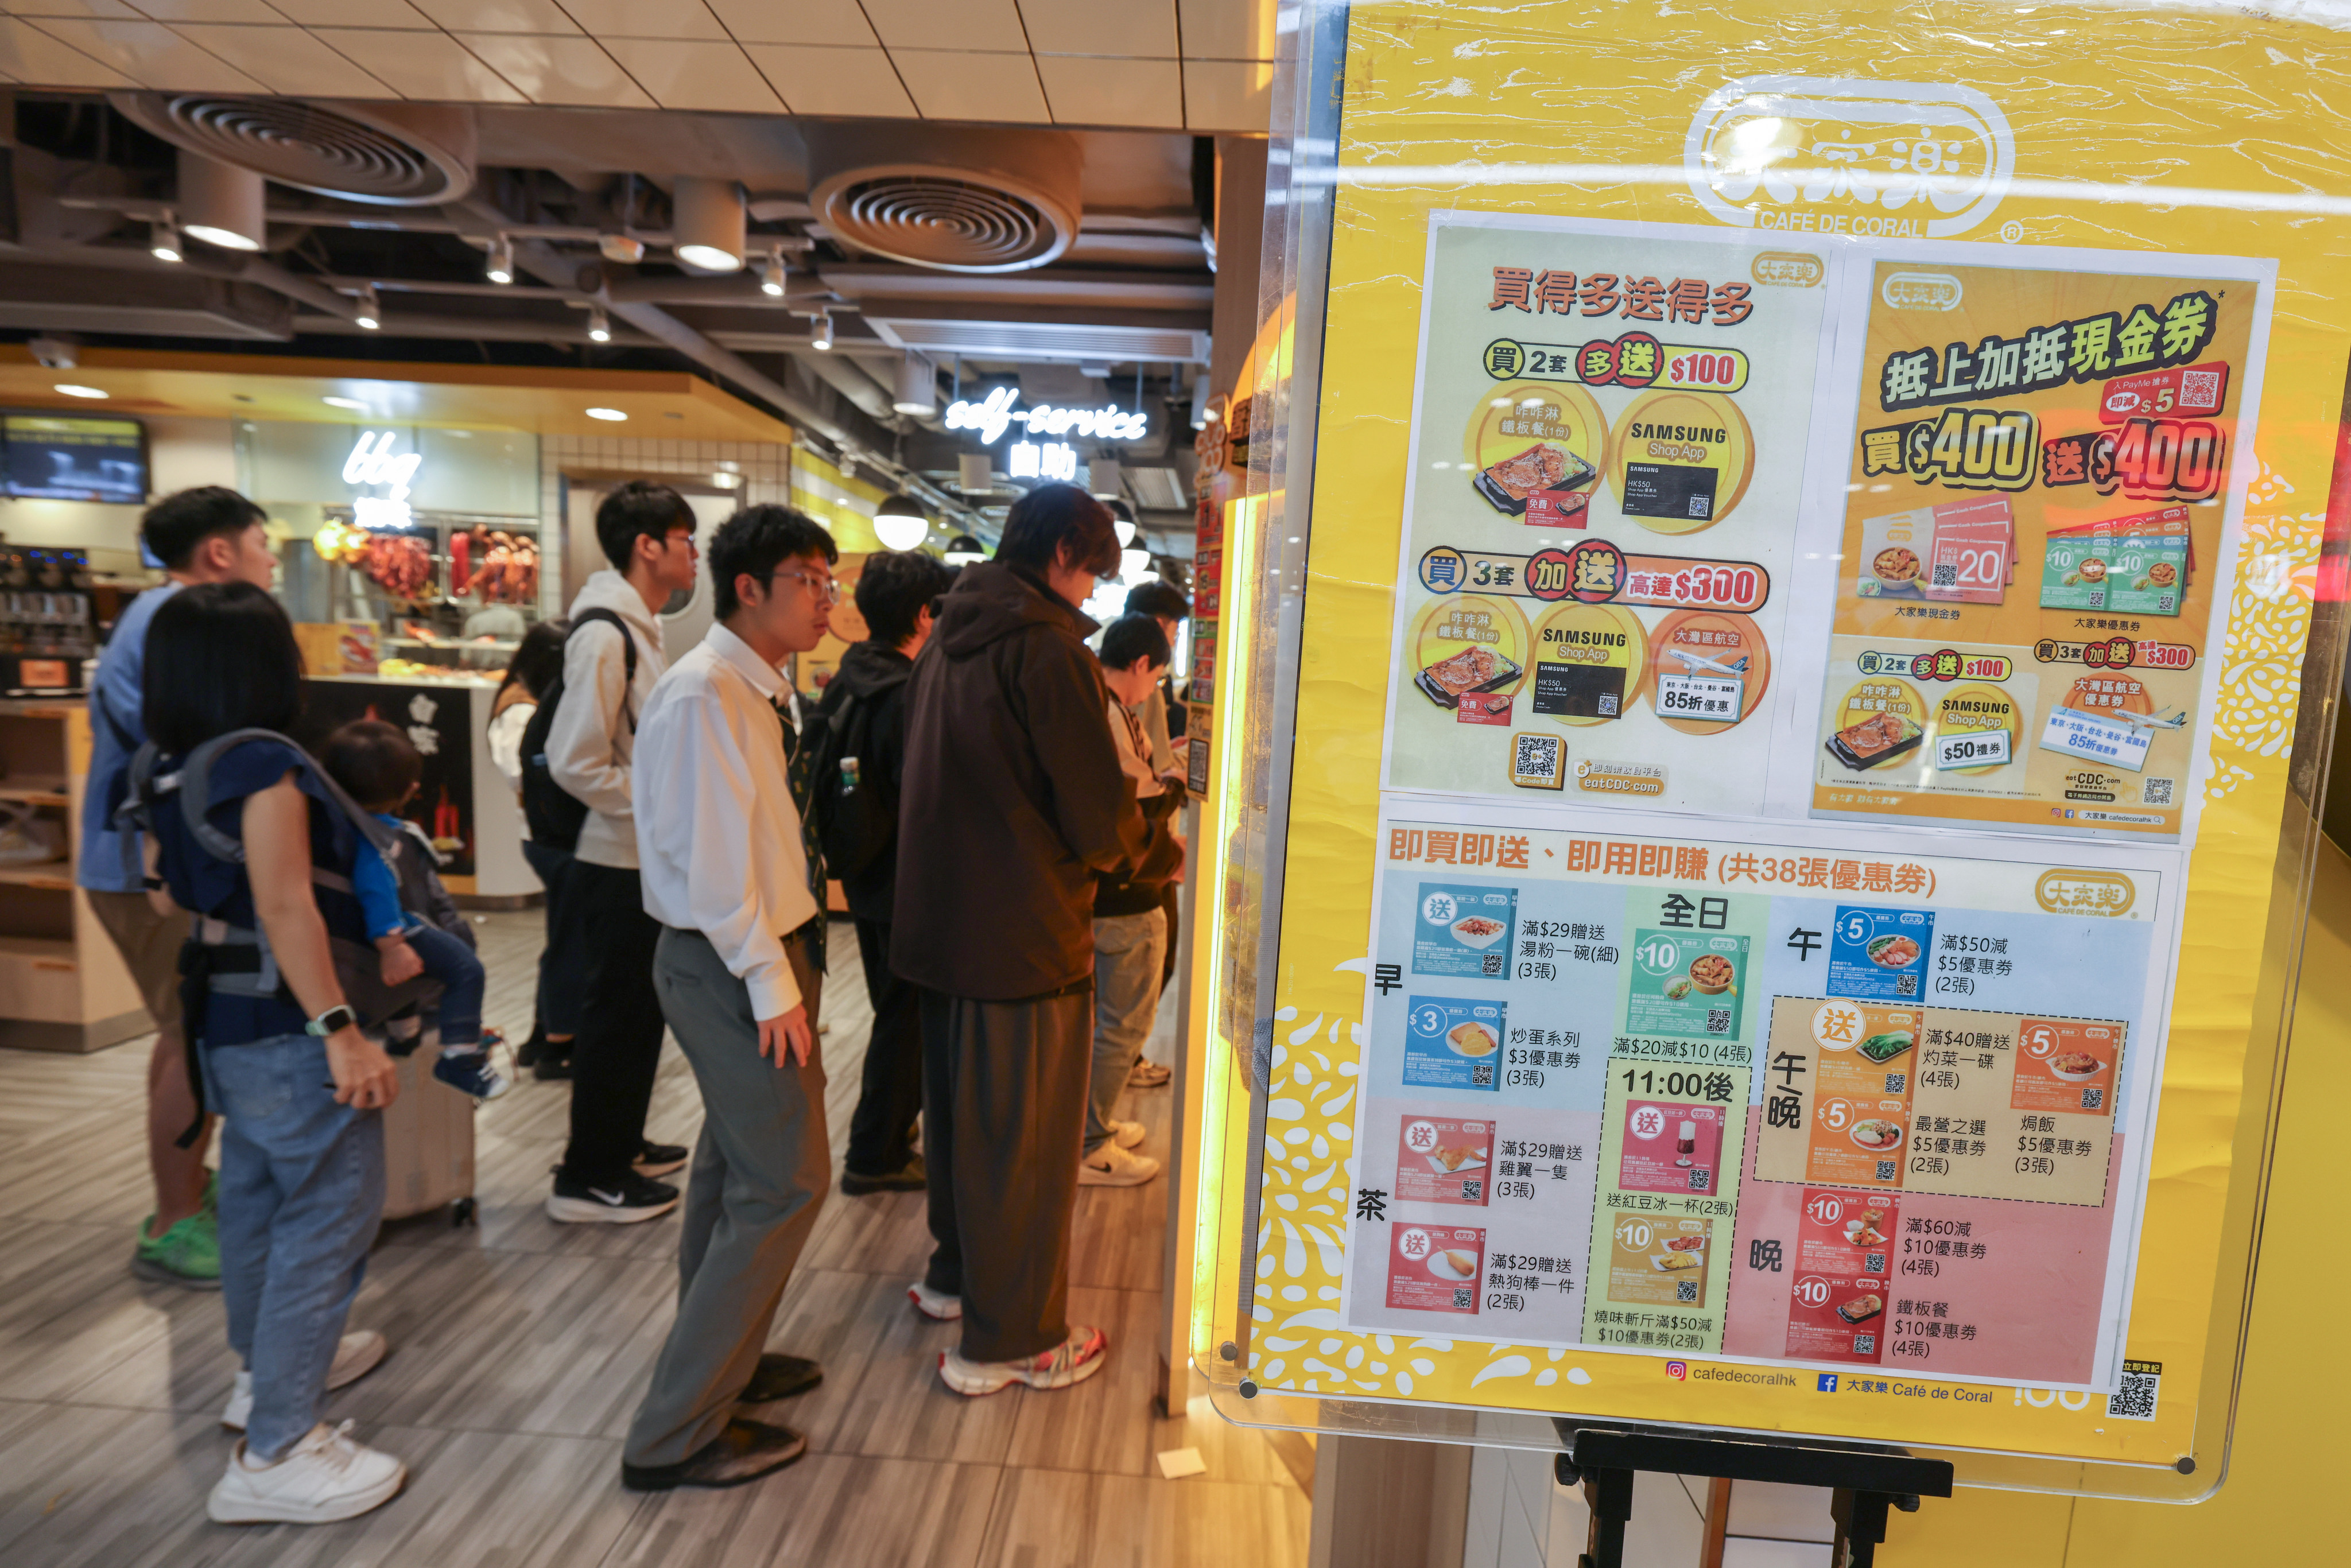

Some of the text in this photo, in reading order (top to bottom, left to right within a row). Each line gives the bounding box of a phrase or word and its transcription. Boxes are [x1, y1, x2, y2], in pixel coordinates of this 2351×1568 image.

[1760, 209, 1924, 238] CAFÉ DE CORAL
[1487, 266, 1753, 325] 買得多送得多
[1491, 347, 1516, 372] 買
[1529, 350, 1567, 374] 2套
[1670, 353, 1736, 386] $100
[2123, 379, 2151, 390] PayMe
[2110, 394, 2136, 408] 即減
[1631, 422, 1727, 444] SAMSUNG
[1650, 443, 1705, 460] Shop App
[1863, 412, 2028, 477] 買 $400
[2046, 421, 2212, 488] 送 $400
[1630, 465, 1659, 473] SAMSUNG
[1628, 480, 1650, 488] HK$50
[1529, 499, 1547, 509] 免費
[1957, 549, 2000, 584] 20
[2046, 549, 2071, 568] $10
[2116, 554, 2142, 572] $10
[1430, 557, 1457, 585] 買
[1473, 561, 1514, 587] 3套
[1543, 628, 1626, 647] SAMSUNG
[1675, 630, 1739, 646] 大灣區航空
[1559, 646, 1608, 662] Shop App
[1733, 659, 1746, 669] GBA
[2039, 643, 2054, 659] 買
[2059, 646, 2082, 659] 3套
[2147, 648, 2189, 666] $300
[1863, 654, 1877, 670] 買
[1884, 657, 1907, 671] 2套
[1966, 658, 2003, 677] $100
[1538, 679, 1560, 688] HK$50
[1461, 700, 1477, 710] 免費
[1942, 699, 2009, 715] SAMSUNG
[1947, 713, 2001, 728] Shop App
[2109, 814, 2152, 823] cafedecoralhk
[1389, 827, 1937, 899] 即買即送、即用即賺 (共38張優惠券)
[1428, 898, 1451, 920] 送
[1659, 893, 1729, 930] 全日
[1522, 919, 1605, 941] 滿$29贈送
[1835, 918, 1864, 940] $5
[1520, 941, 1619, 964] 湯粉一碗(細)
[1787, 927, 1822, 962] 午
[1941, 933, 2008, 954] 滿$50減
[1635, 942, 1675, 969] $10
[1375, 964, 1403, 996] 早
[1518, 961, 1557, 981] (3張)
[1935, 975, 1975, 996] (2張)
[1409, 1010, 1437, 1031] $3
[1819, 1008, 1856, 1043] 送
[1510, 1027, 1580, 1048] 炒蛋系列
[1925, 1028, 2011, 1050] 滿$40贈送
[2020, 1030, 2050, 1054] $5
[1613, 1036, 1752, 1064] 滿$20減$10 (4張)
[1922, 1050, 1995, 1071] 灼菜一碟
[1506, 1069, 1545, 1089] (3張)
[1621, 1069, 1734, 1103] 11:00後
[1920, 1070, 1960, 1091] (4張)
[1636, 1112, 1659, 1134] 送
[1818, 1103, 1846, 1128] $5
[1915, 1115, 1987, 1137] 最營之選
[2019, 1116, 2055, 1135] 焗飯
[1411, 1126, 1432, 1147] 送
[1500, 1139, 1582, 1162] 滿$29贈送
[1498, 1159, 1569, 1181] 雞翼一隻
[1909, 1155, 1950, 1175] (2張)
[2014, 1156, 2055, 1176] (3張)
[1496, 1181, 1535, 1201] (3張)
[1356, 1188, 1388, 1221] 茶
[1607, 1192, 1734, 1218] 送紅豆冰一杯(2張)
[1806, 1200, 1840, 1221] $10
[1615, 1224, 1650, 1246] $10
[1906, 1216, 1972, 1237] 滿$60減
[1405, 1234, 1425, 1255] 送
[1491, 1252, 1572, 1275] 滿$29贈送
[1749, 1239, 1783, 1273] 晚
[1900, 1257, 1941, 1278] (4張)
[1488, 1272, 1576, 1295] 熱狗棒一件
[1793, 1282, 1827, 1303] $10
[1486, 1293, 1525, 1313] (2張)
[1896, 1299, 1949, 1318] 鐵板餐
[1892, 1338, 1931, 1359] (4張)
[1693, 1368, 1797, 1387] cafedecoralhk
[2123, 1362, 2160, 1373] 立即登記
[1846, 1379, 1888, 1396] 大家樂
[1893, 1381, 1929, 1399] Café
[1931, 1384, 1950, 1401] de
[1953, 1387, 1993, 1404] Coral
